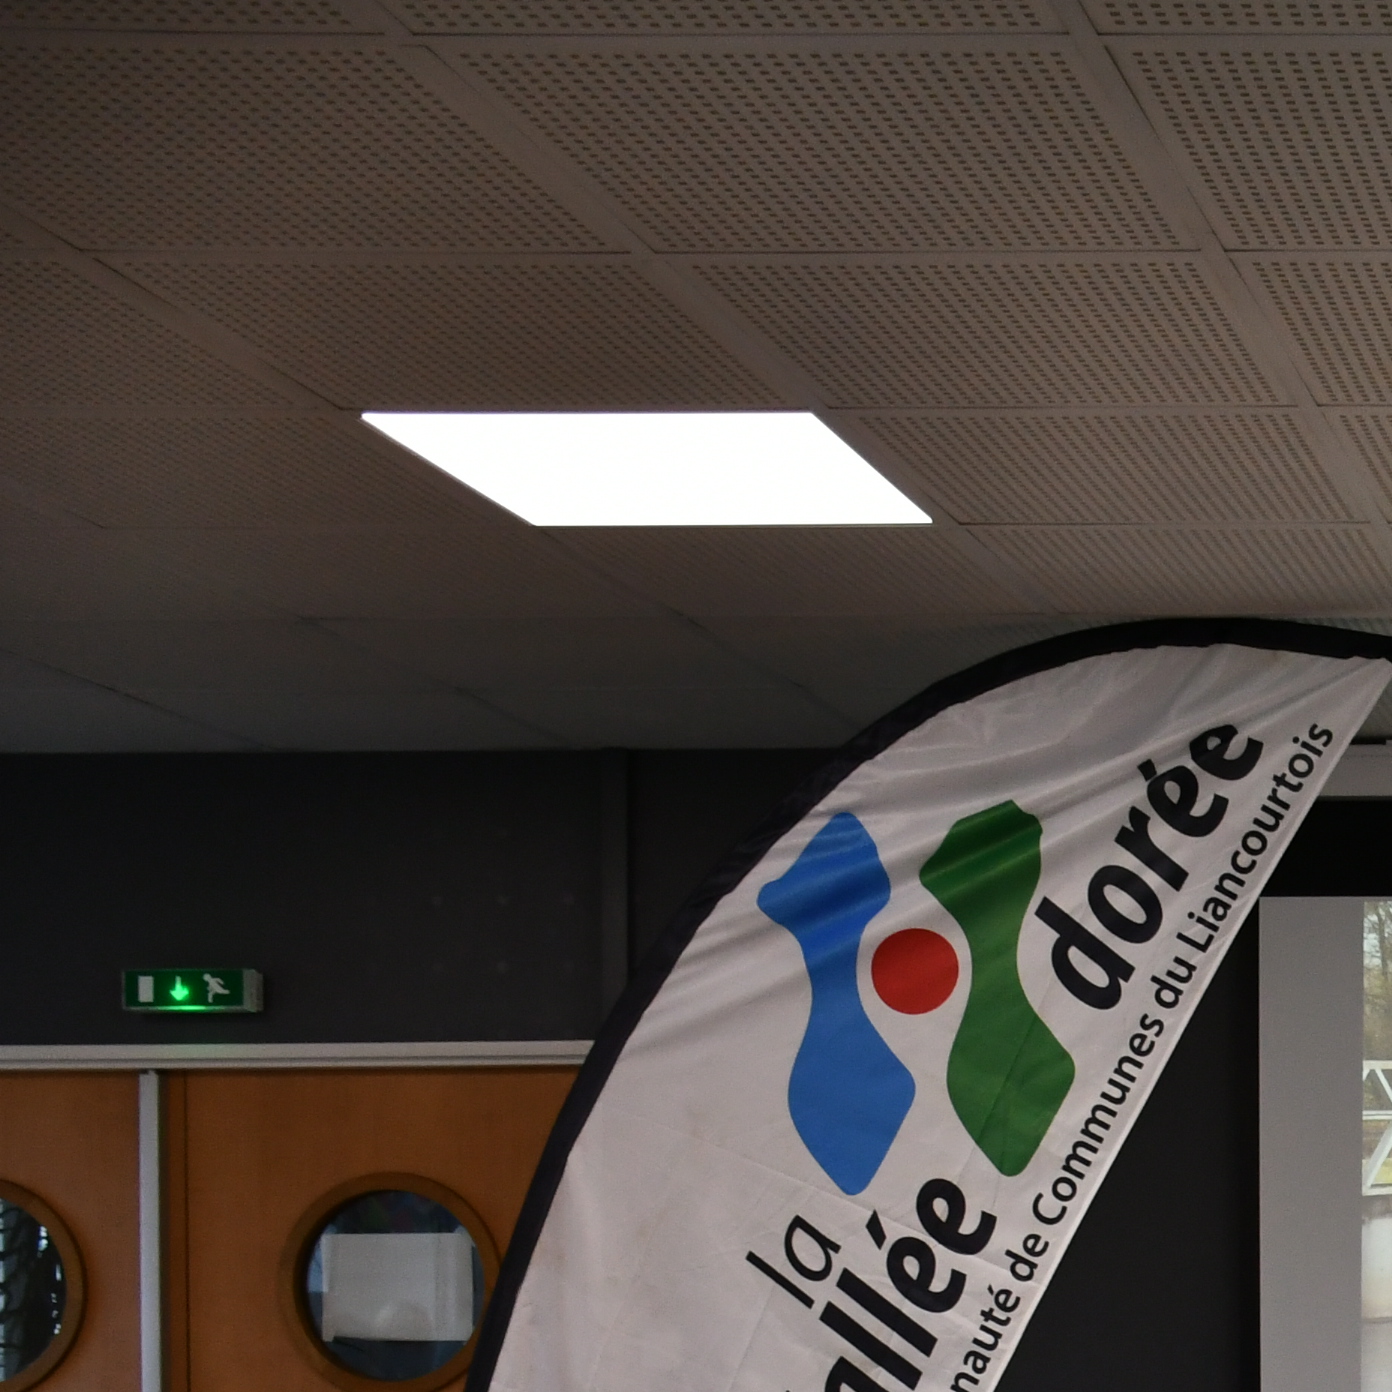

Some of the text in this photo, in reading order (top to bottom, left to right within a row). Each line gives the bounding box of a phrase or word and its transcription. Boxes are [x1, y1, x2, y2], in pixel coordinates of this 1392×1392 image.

[1004, 1233, 1049, 1282] de
[1032, 1013, 1165, 1225] Communes
[1150, 956, 1198, 1008] du
[1176, 723, 1334, 953] Liancourtois
[1034, 723, 1264, 1010] dorée
[745, 1214, 841, 1309] la
